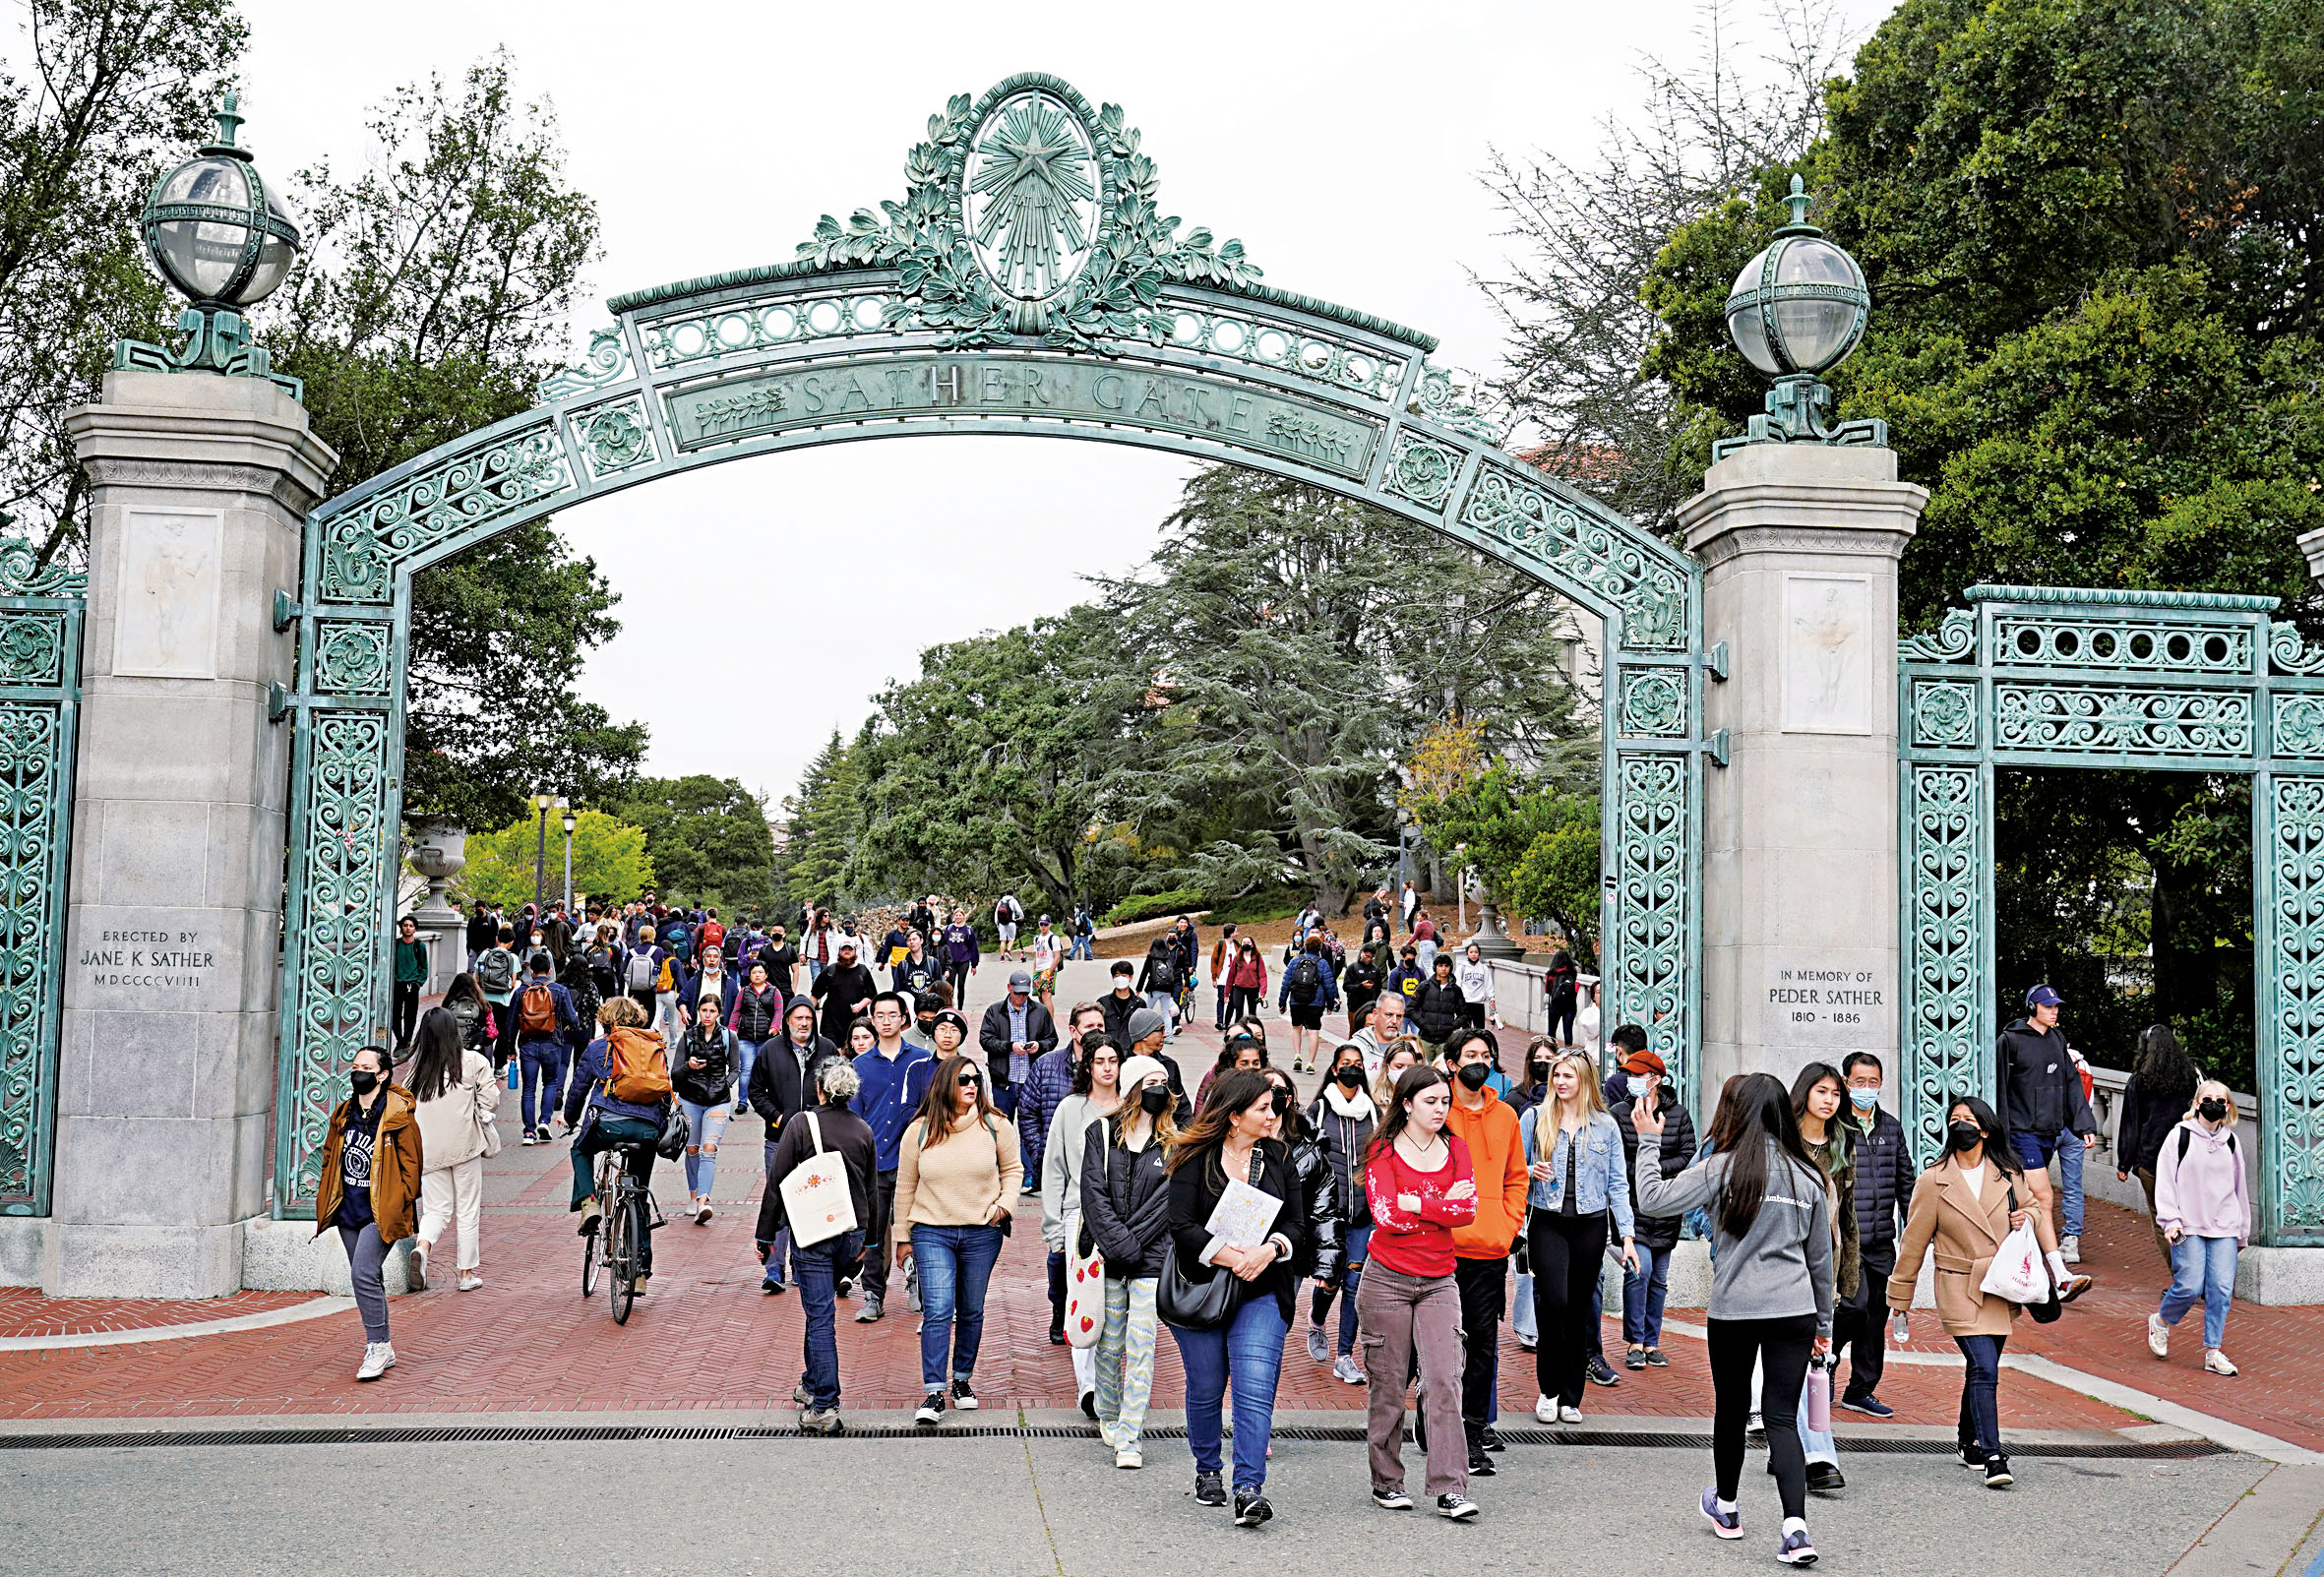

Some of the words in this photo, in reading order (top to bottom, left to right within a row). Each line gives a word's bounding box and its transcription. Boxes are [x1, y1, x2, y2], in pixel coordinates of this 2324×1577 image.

[1034, 195, 1055, 208] LUX
[803, 364, 1052, 413] SATHER
[1091, 373, 1253, 433] GATE
[102, 931, 168, 942] ERECTED
[180, 932, 198, 943] BY
[80, 949, 124, 966] JANE
[132, 950, 144, 966] K
[151, 951, 214, 968] SATHER
[1781, 970, 1792, 980] IN
[1798, 971, 1852, 982] MEMORY
[1856, 972, 1872, 982] OF
[1769, 988, 1820, 1003] PEDER
[1826, 990, 1883, 1005] SATHER
[1792, 1011, 1816, 1022] 1810
[1833, 1012, 1861, 1024] 1886
[354, 1131, 376, 1159] YOR
